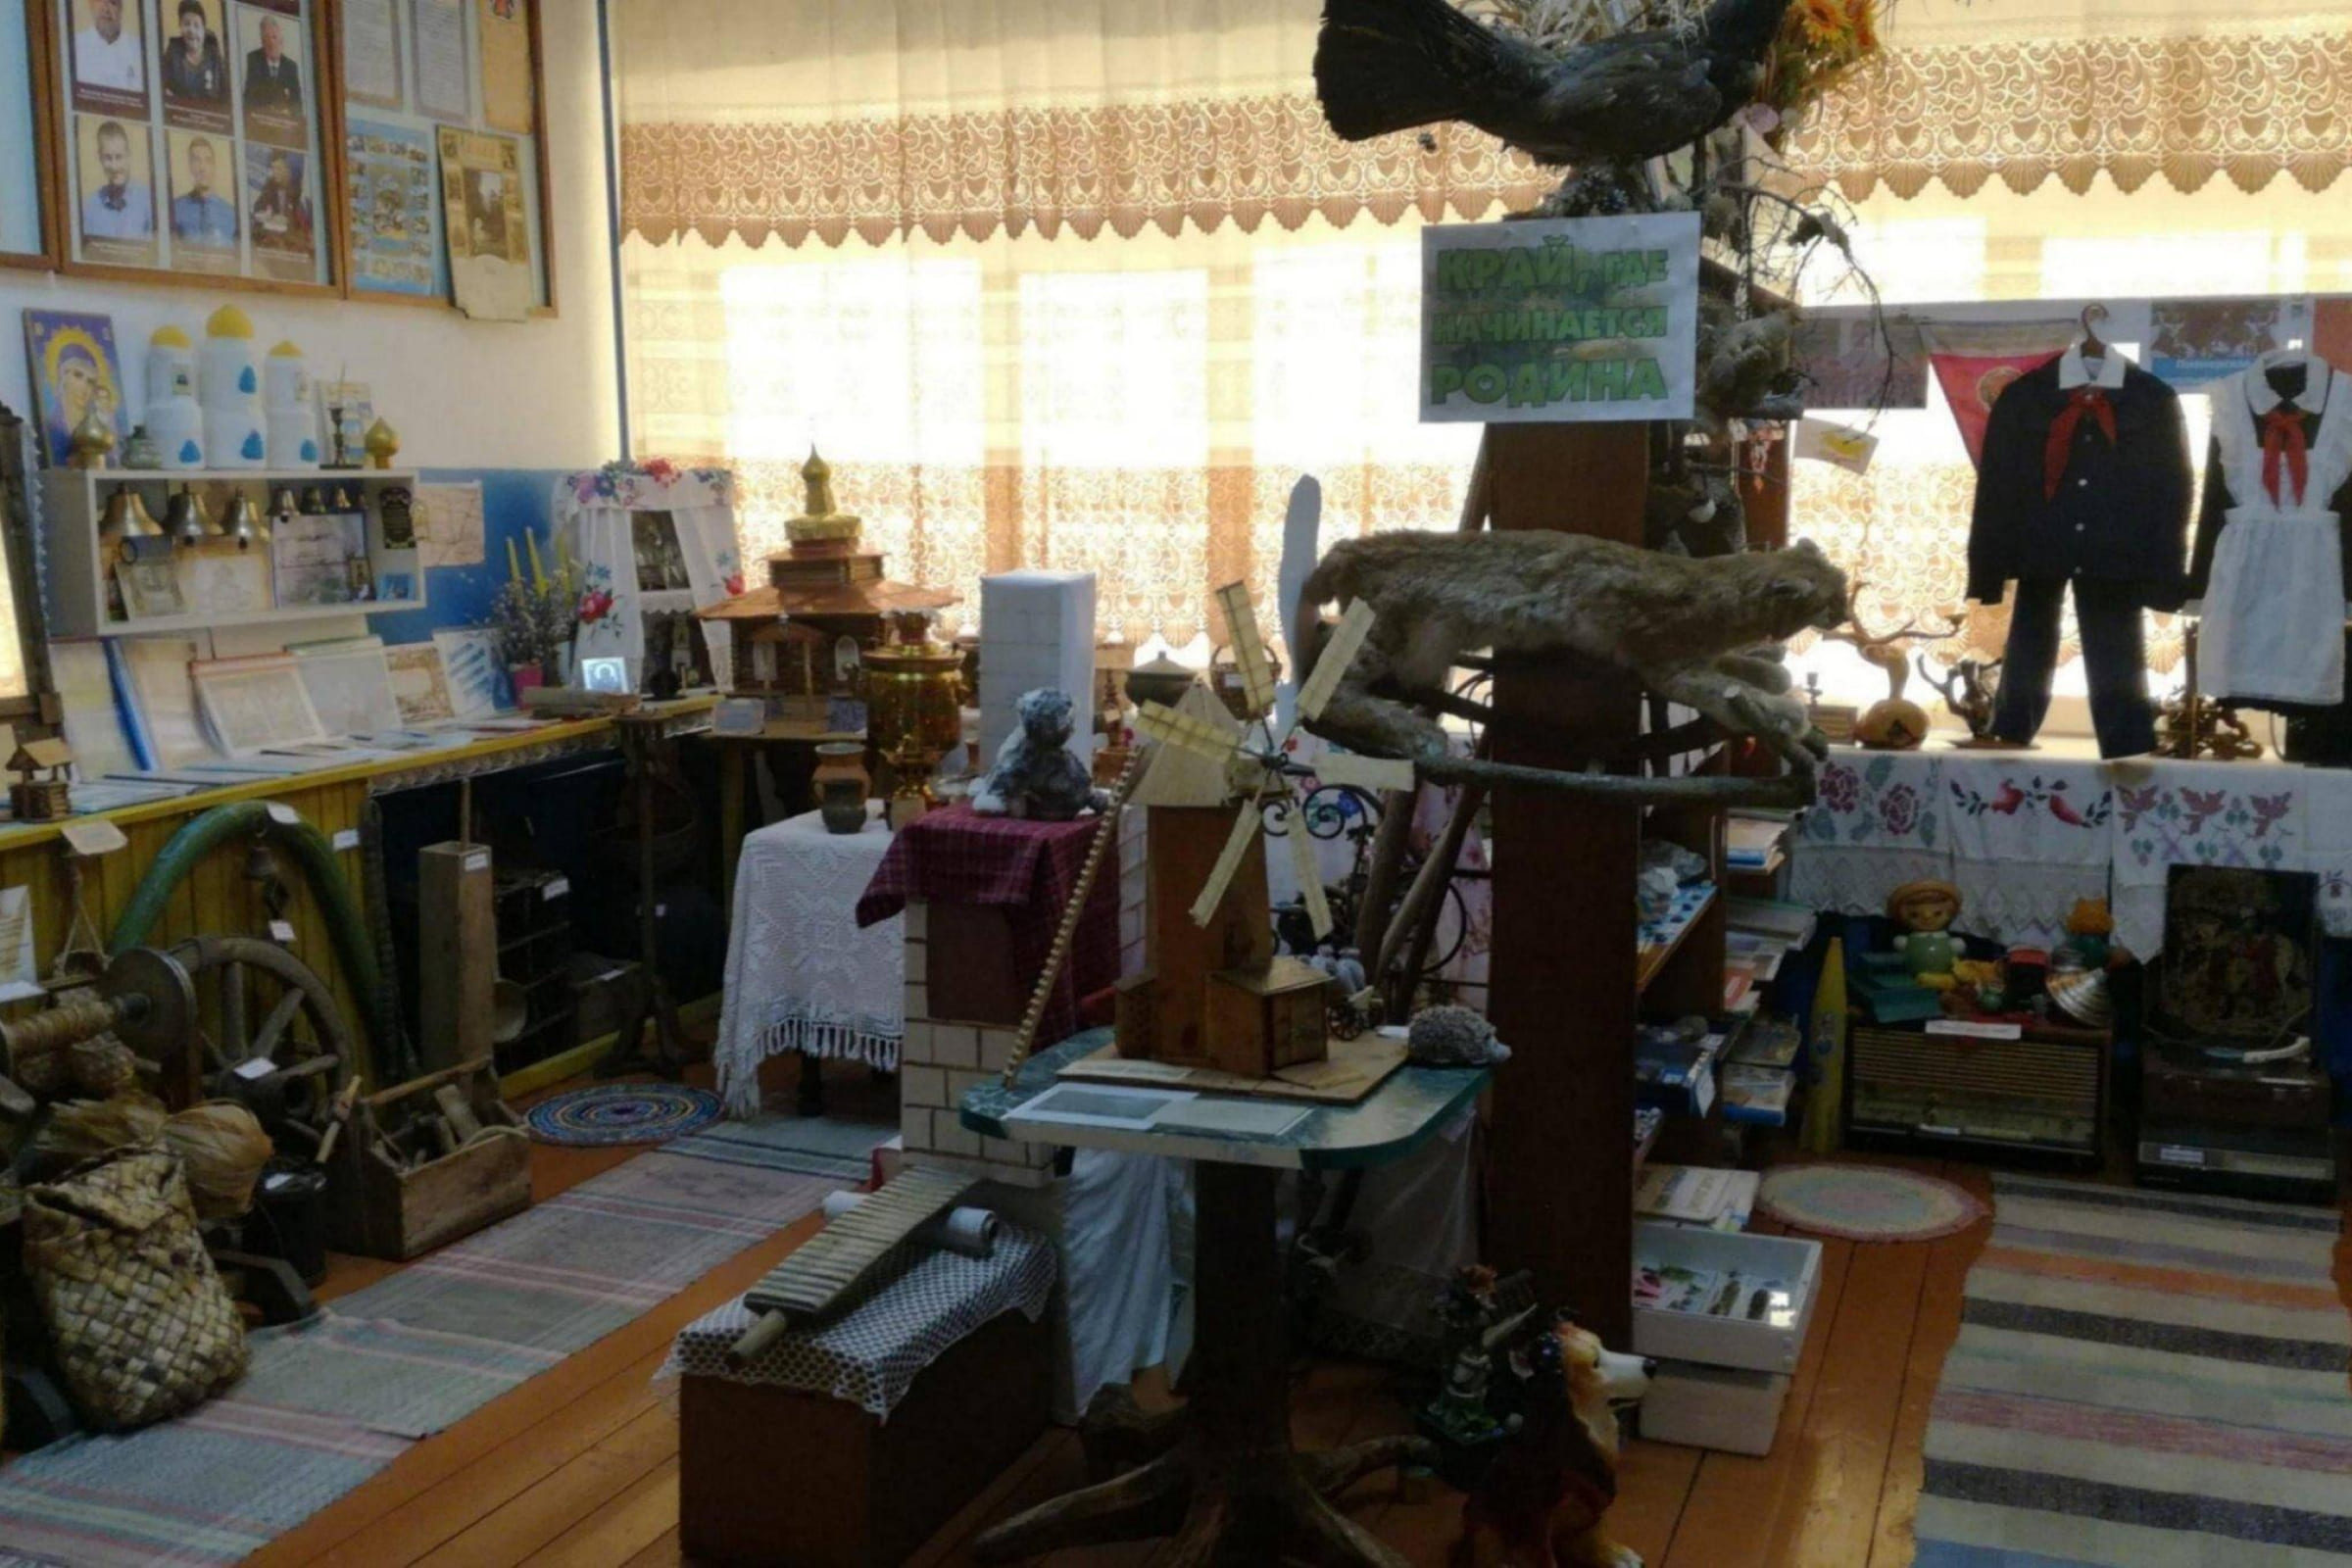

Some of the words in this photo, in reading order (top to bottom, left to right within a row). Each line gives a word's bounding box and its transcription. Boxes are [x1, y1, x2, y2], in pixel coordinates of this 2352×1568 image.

[1437, 234, 1591, 293] КРАЙ,
[1602, 249, 1669, 287] ГДЕ
[1432, 306, 1668, 342] НАЧИНАЕТСЯ
[1431, 358, 1668, 408] РОДИНА
